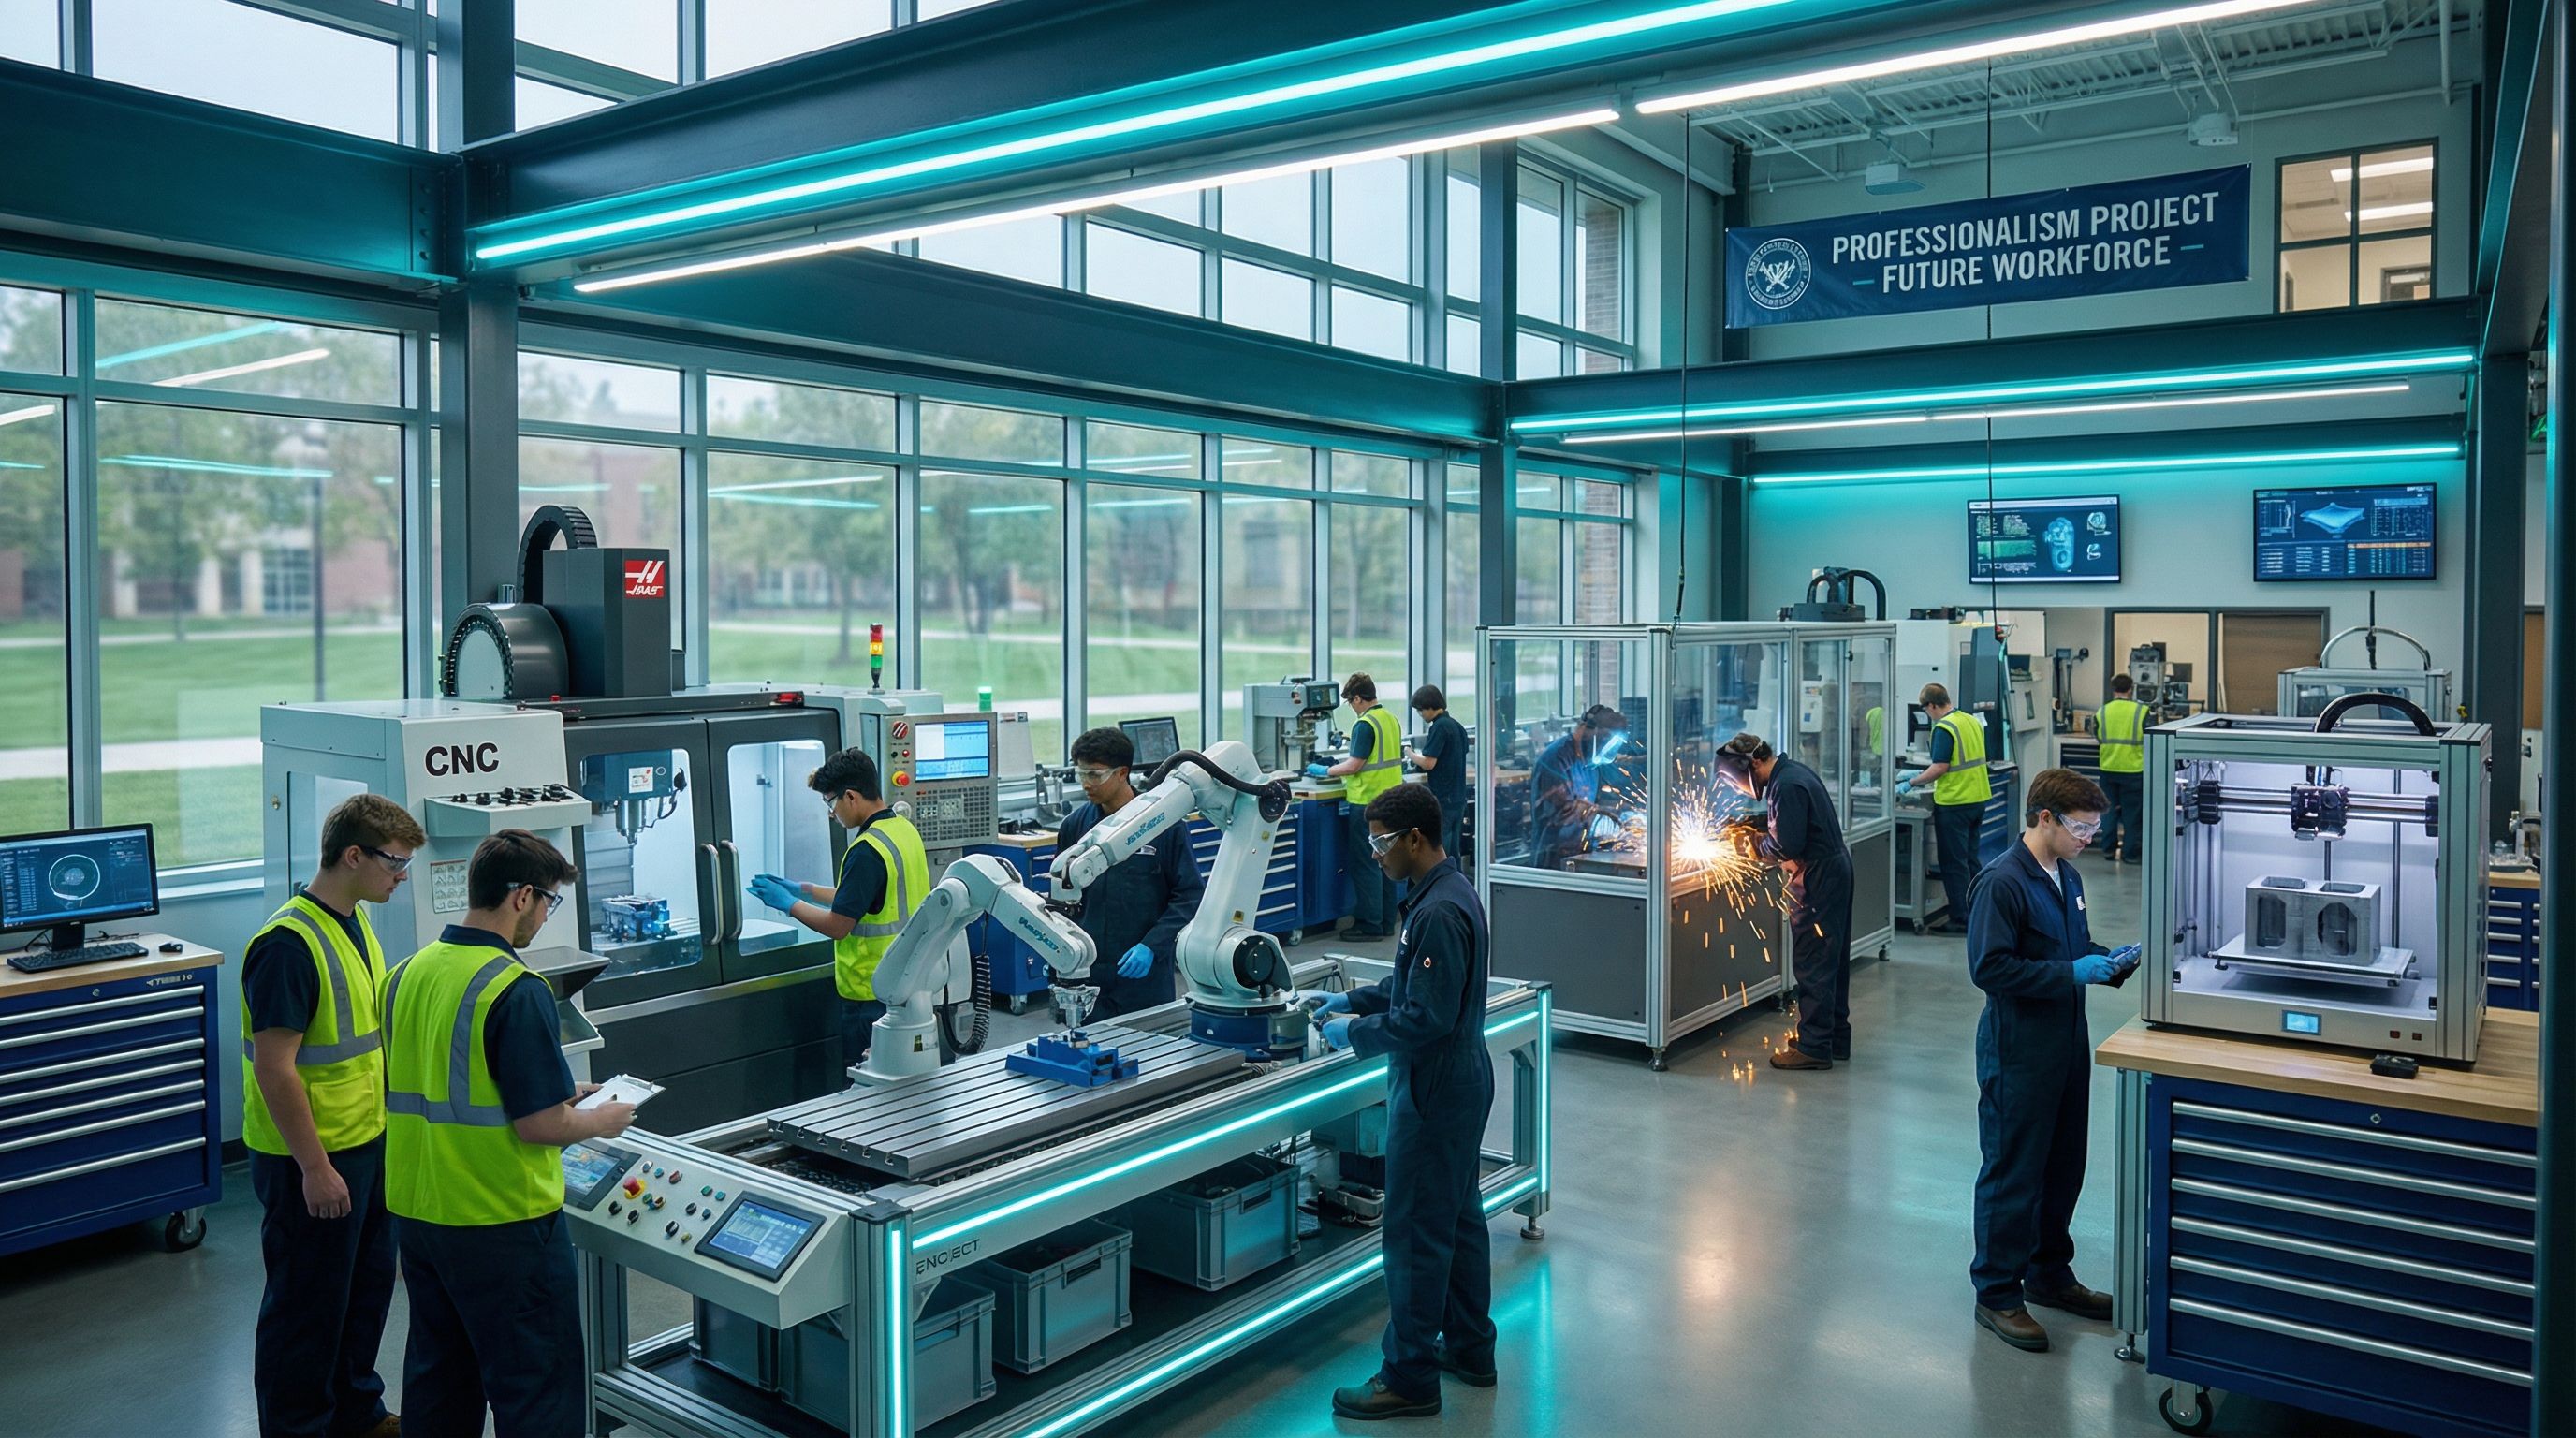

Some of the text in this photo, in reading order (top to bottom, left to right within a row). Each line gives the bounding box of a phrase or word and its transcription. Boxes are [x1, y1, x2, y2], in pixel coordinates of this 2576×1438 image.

[1832, 191, 2219, 264] PROFESSIONALISM PROJECT
[1883, 235, 2171, 293] FUTURE WORKFORCE
[425, 742, 500, 777] CNC
